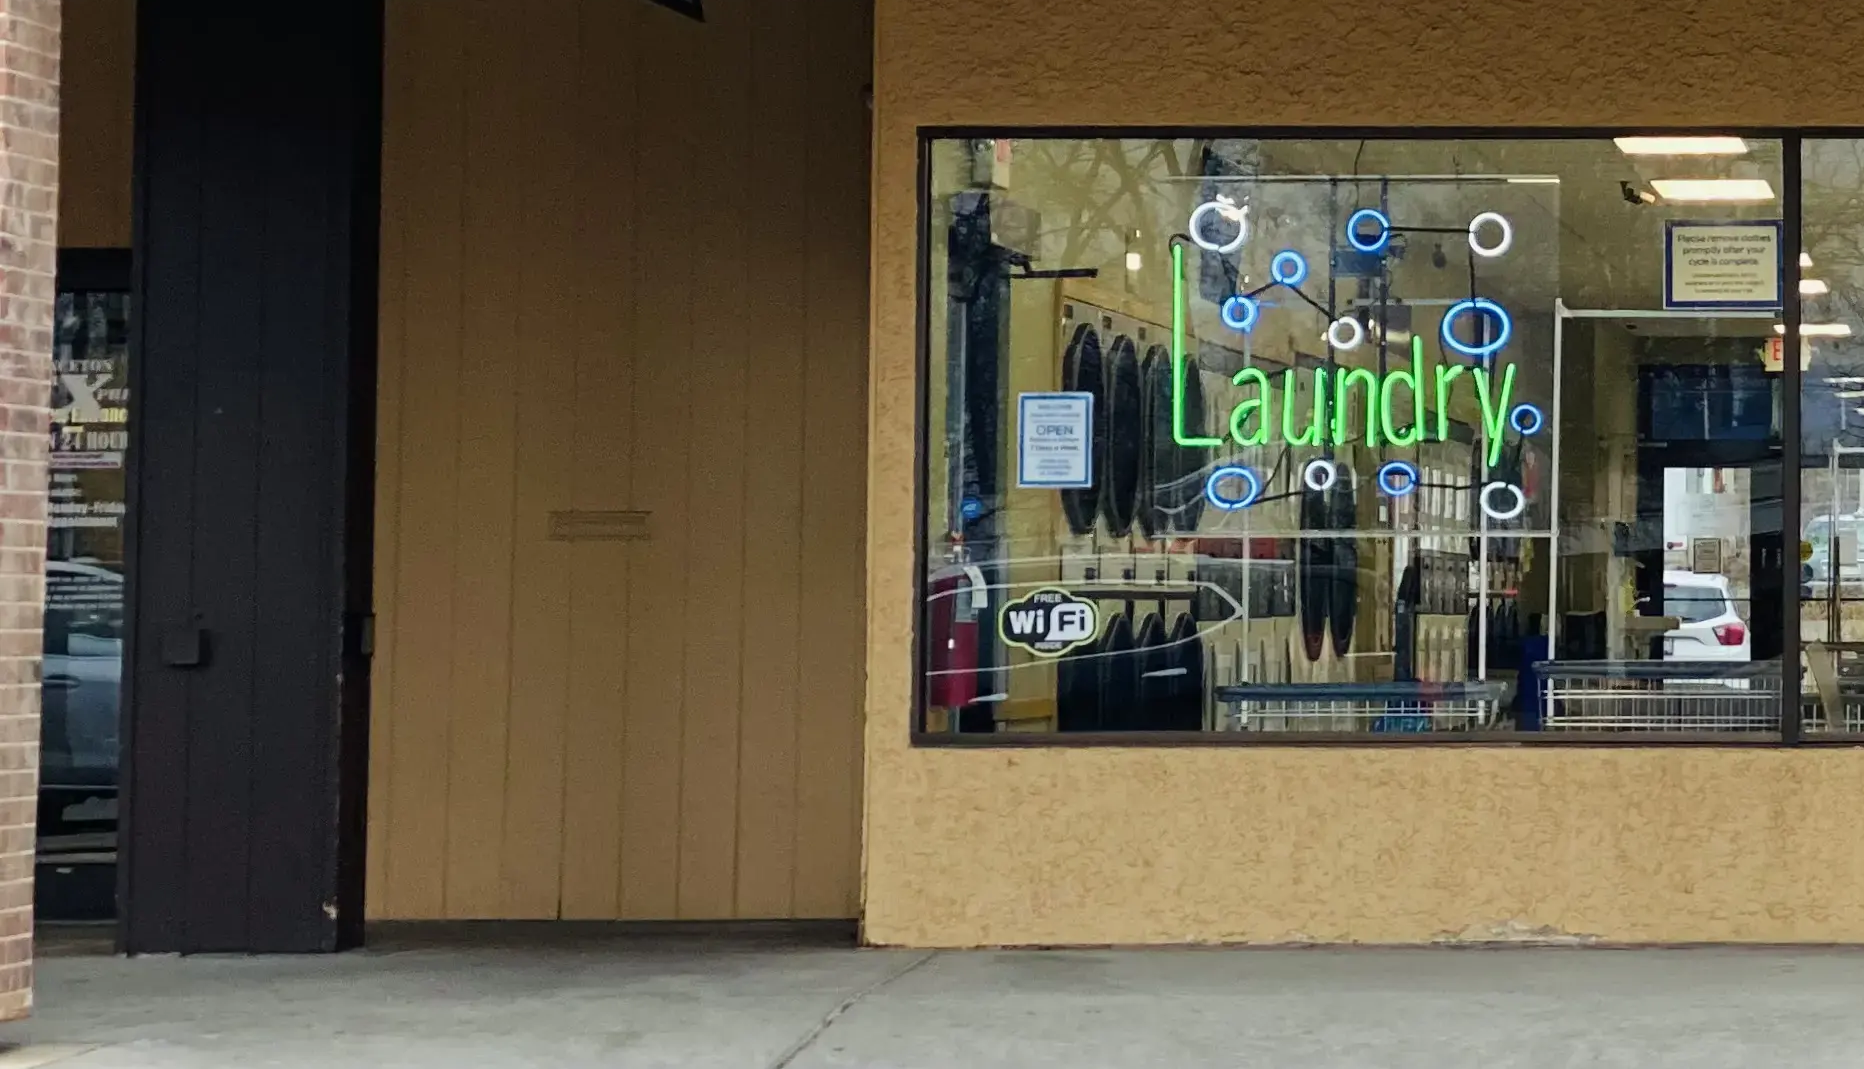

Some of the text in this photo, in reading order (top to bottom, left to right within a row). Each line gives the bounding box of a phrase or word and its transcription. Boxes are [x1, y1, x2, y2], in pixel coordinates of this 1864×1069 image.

[1677, 234, 1706, 243] Please
[1172, 242, 1517, 468] Laundry
[1036, 424, 1073, 436] OPEN
[1033, 593, 1062, 603] FREE
